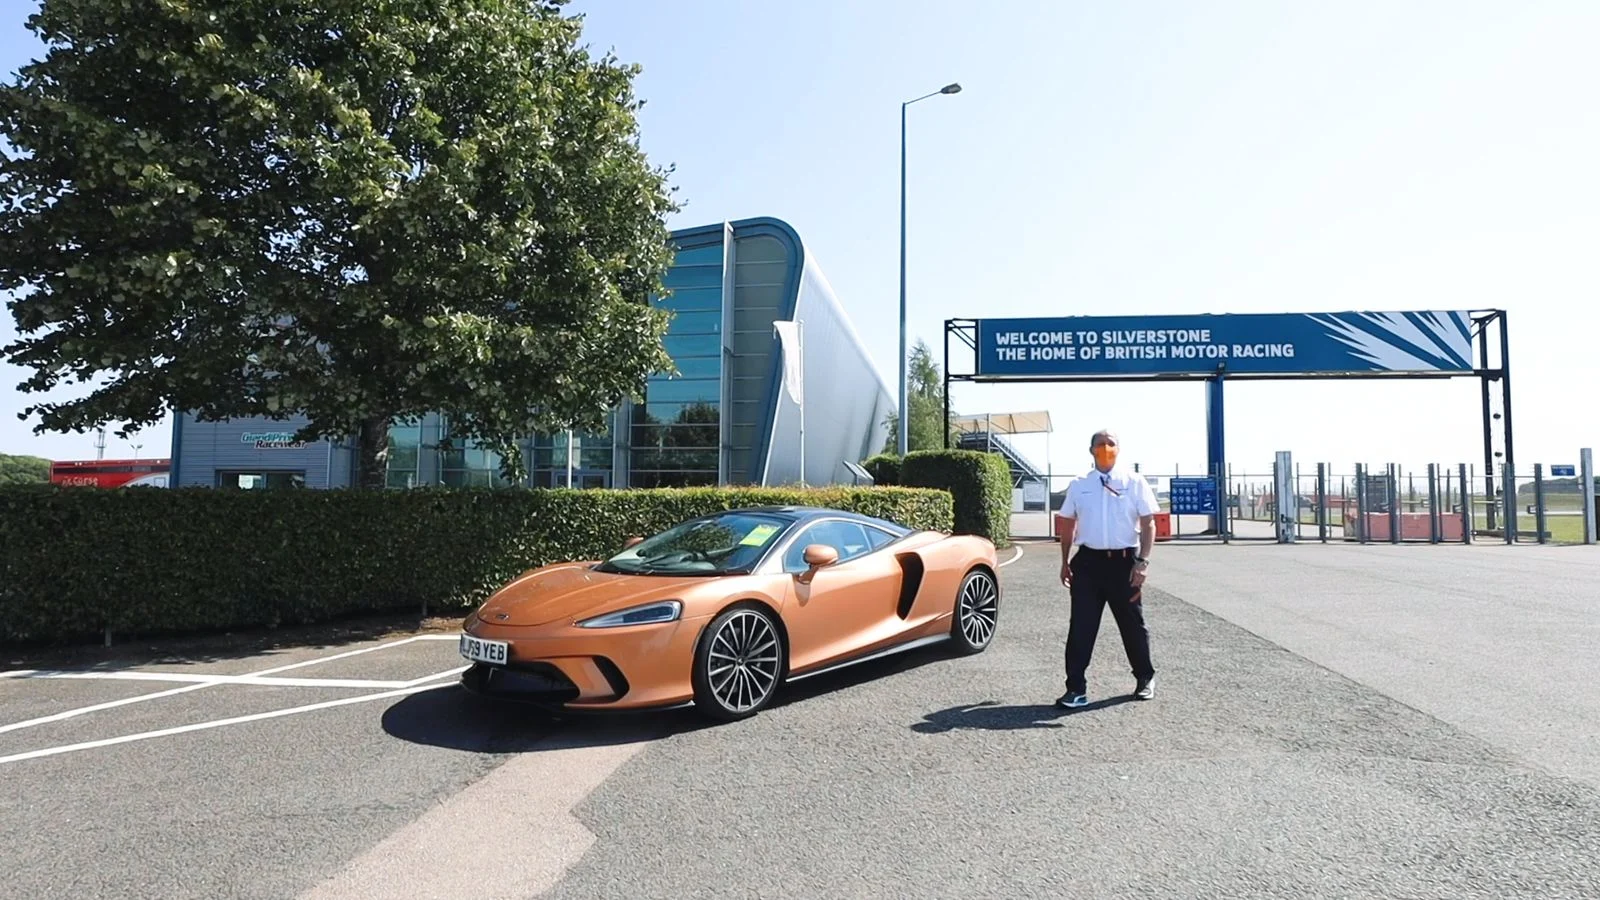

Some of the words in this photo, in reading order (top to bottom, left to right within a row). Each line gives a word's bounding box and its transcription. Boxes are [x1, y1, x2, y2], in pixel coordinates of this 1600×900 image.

[996, 332, 1073, 345] WELCOME
[1076, 331, 1098, 344] TO
[1102, 329, 1211, 344] SILVERSTONE
[996, 348, 1027, 361] THE
[1030, 347, 1076, 360] HOME
[1079, 347, 1101, 360] OF
[1105, 345, 1167, 359] BRITISH
[1171, 344, 1229, 359] MOTOR
[1232, 344, 1295, 358] RACING
[483, 642, 505, 661] YEB
